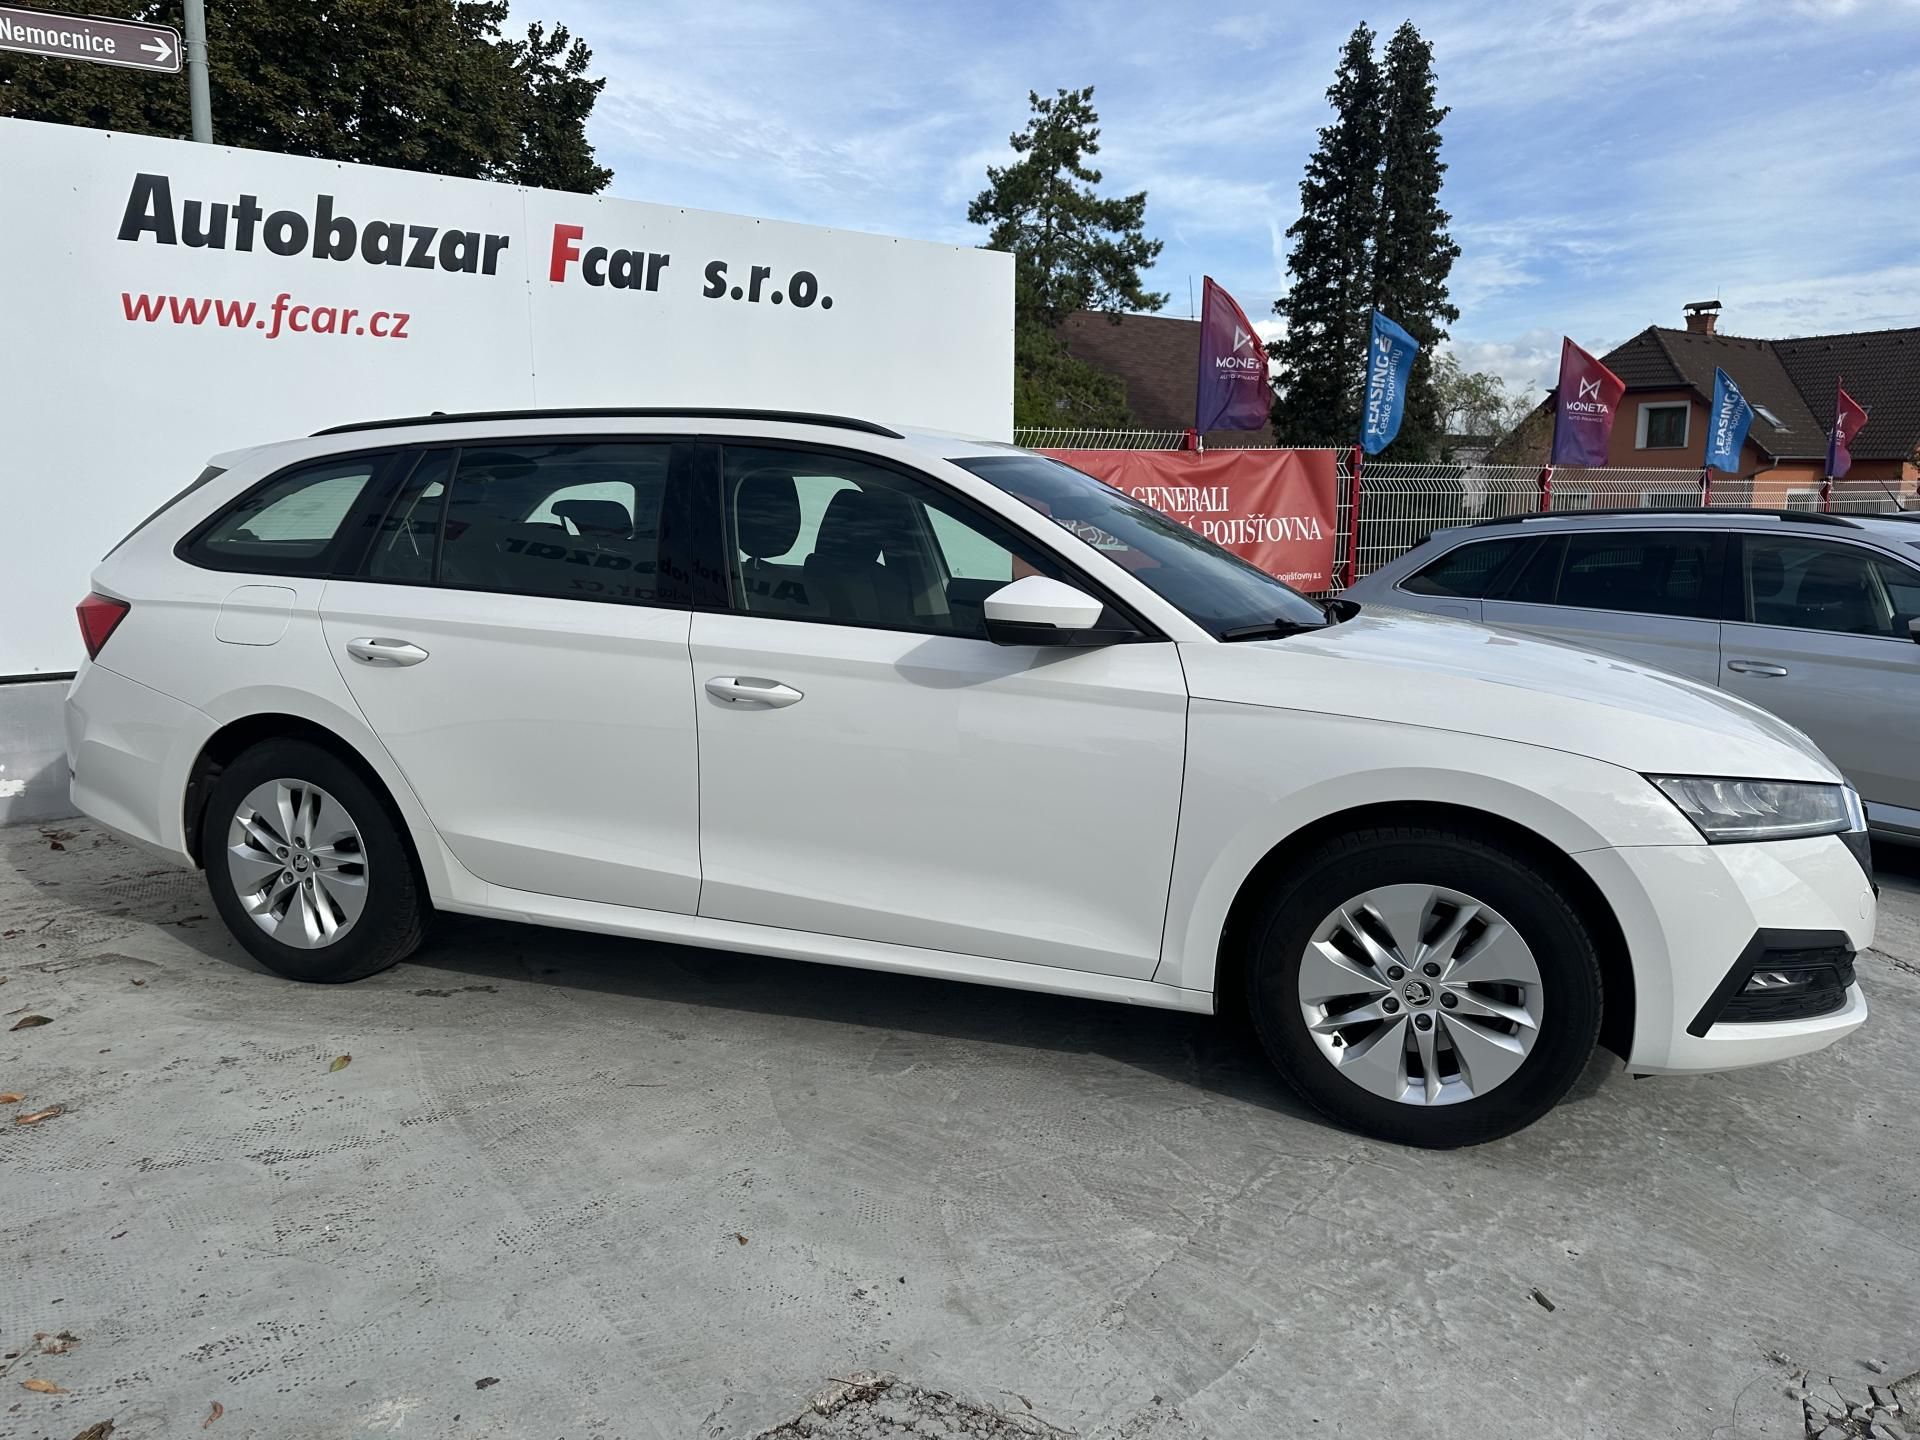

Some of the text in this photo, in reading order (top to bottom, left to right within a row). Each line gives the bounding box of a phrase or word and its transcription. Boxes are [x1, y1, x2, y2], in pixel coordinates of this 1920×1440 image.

[0, 17, 116, 54] Nemocnice
[117, 173, 834, 309] Autobazar Fcar s.r.o.
[121, 291, 410, 340] www.fcar.cz
[1367, 354, 1390, 434] LEASING
[1566, 401, 1609, 414] MONETA
[1714, 393, 1739, 455] LEASING
[1131, 486, 1229, 512] GENERALI
[1201, 513, 1323, 545] POJIŠŤOVNA
